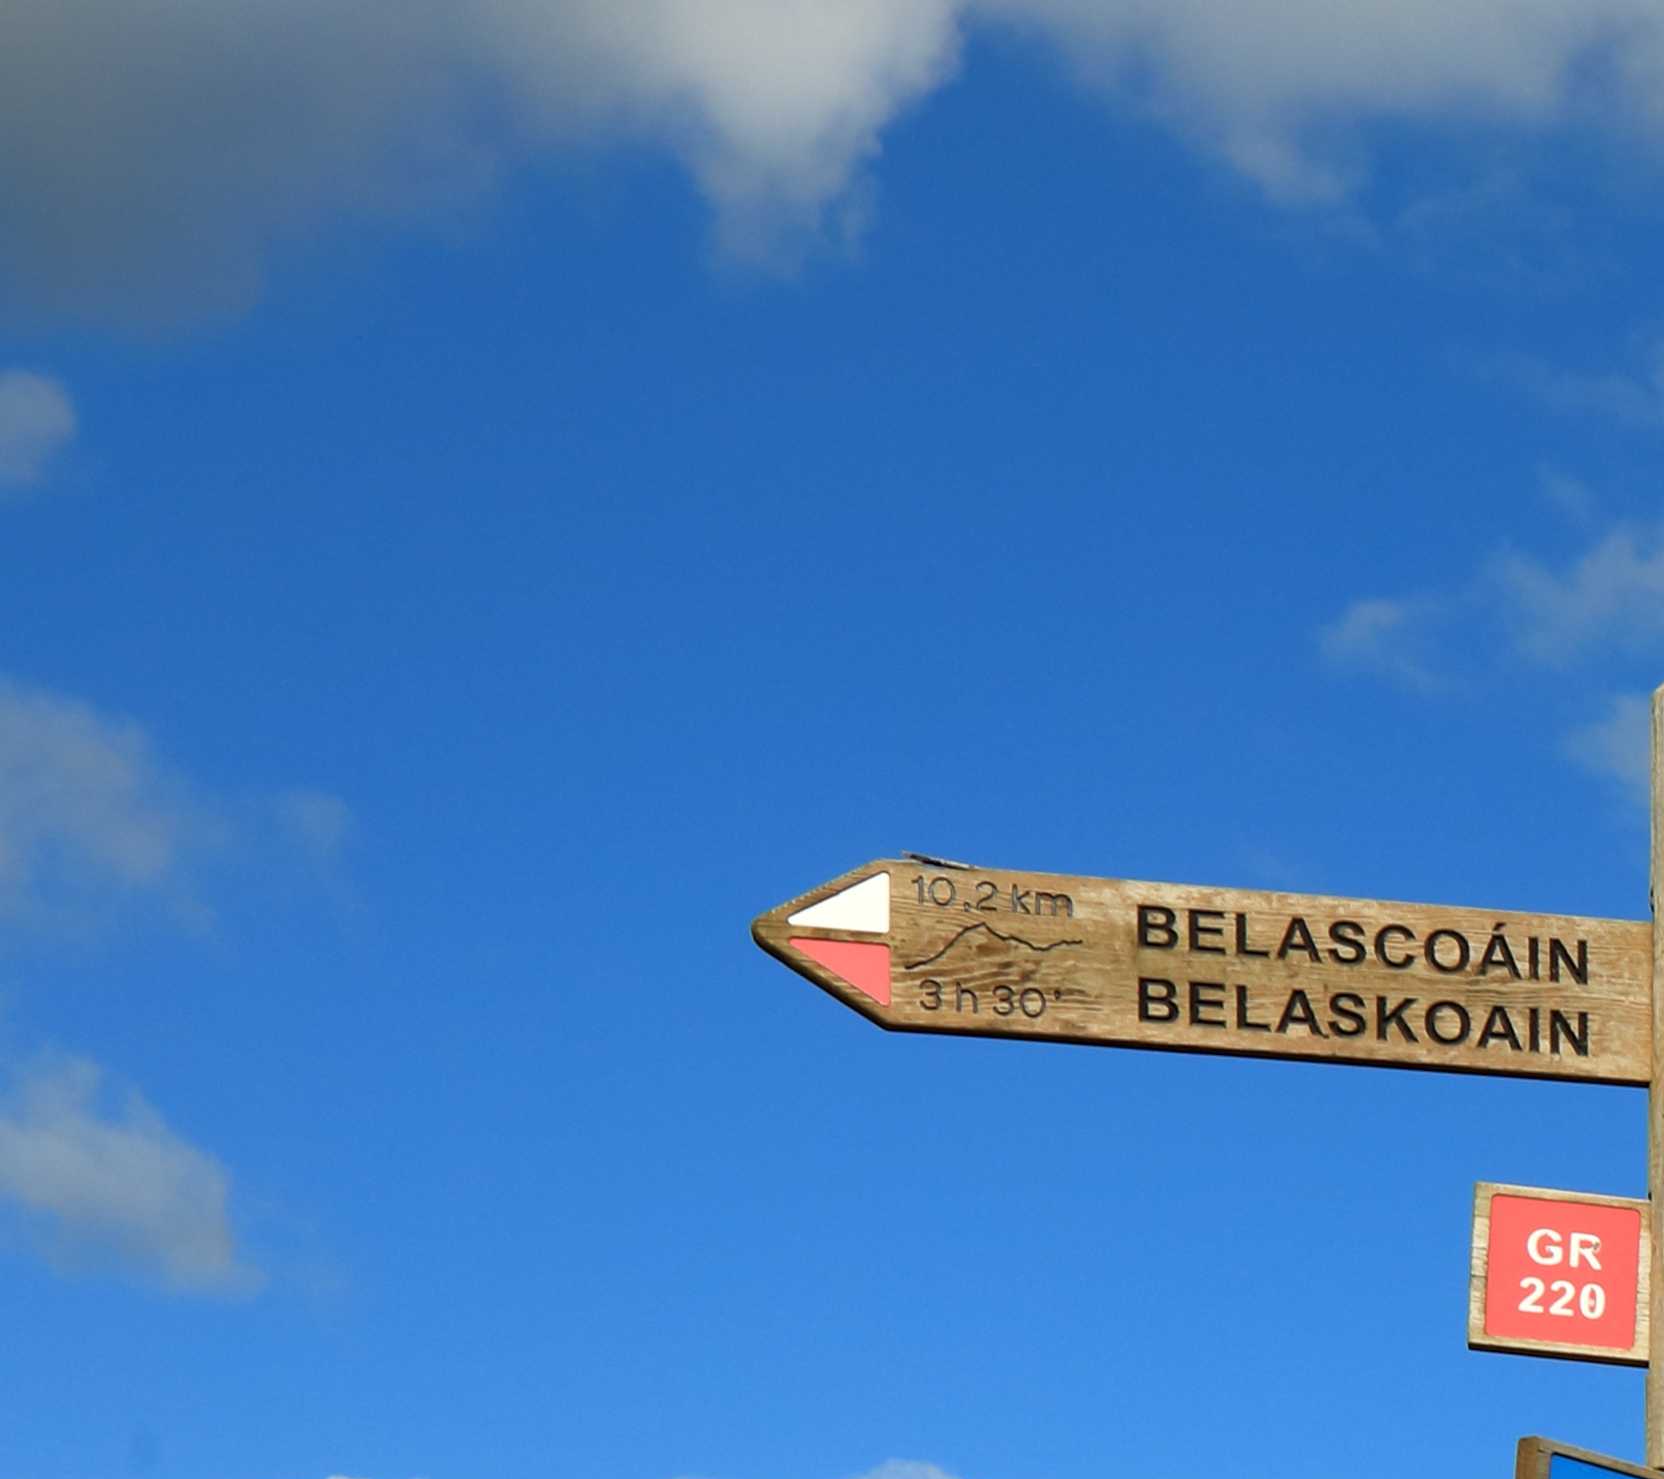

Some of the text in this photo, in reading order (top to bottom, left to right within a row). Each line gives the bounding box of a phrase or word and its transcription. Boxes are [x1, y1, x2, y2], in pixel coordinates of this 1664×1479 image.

[1011, 883, 1074, 917] km
[1136, 903, 1590, 986] BELASCOÁIN
[1137, 976, 1590, 1057] BELASKOAIN
[1526, 1228, 1604, 1271] GR
[1518, 1276, 1606, 1320] 220
